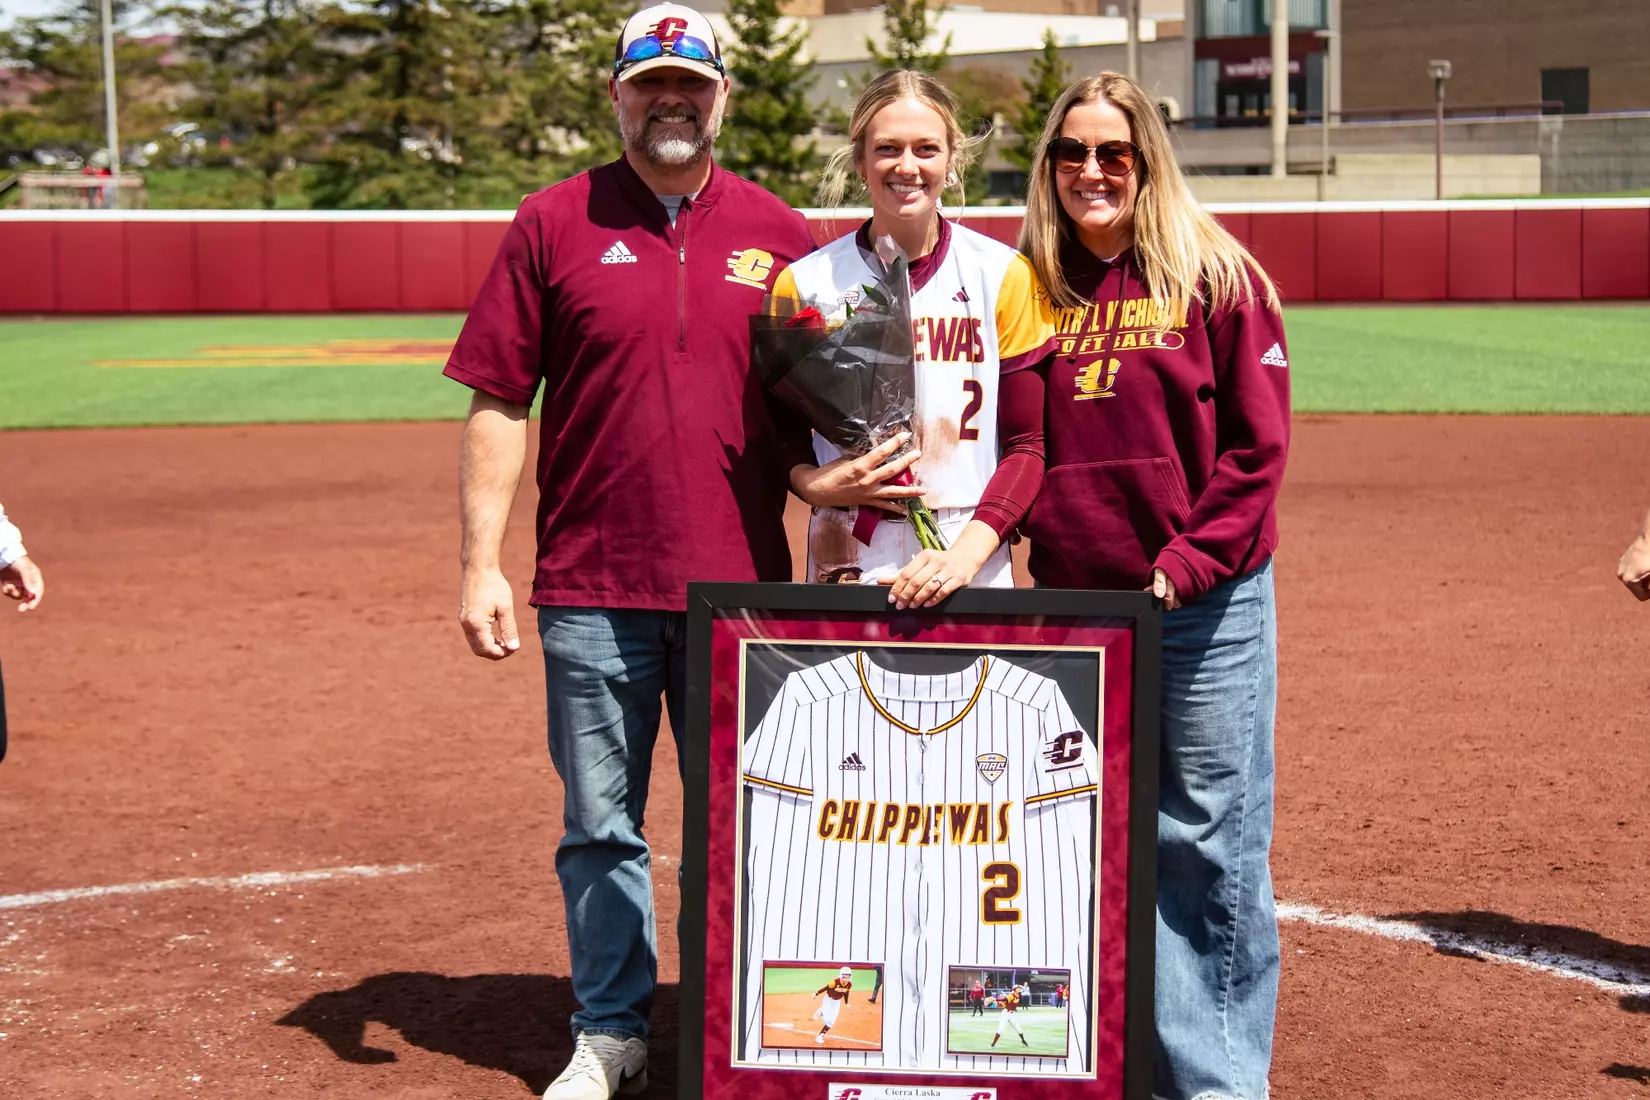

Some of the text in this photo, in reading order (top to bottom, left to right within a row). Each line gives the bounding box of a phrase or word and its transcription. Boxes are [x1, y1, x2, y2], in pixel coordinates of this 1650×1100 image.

[600, 255, 638, 265] adidas
[1260, 356, 1288, 367] adidas
[959, 379, 983, 441] 2
[1043, 730, 1084, 765] C
[838, 763, 866, 771] adidas
[979, 762, 1006, 770] MAC
[817, 798, 1013, 846] CHIPPEWAS
[981, 861, 1021, 925] 2
[884, 1087, 941, 1097] Cierra Laska
